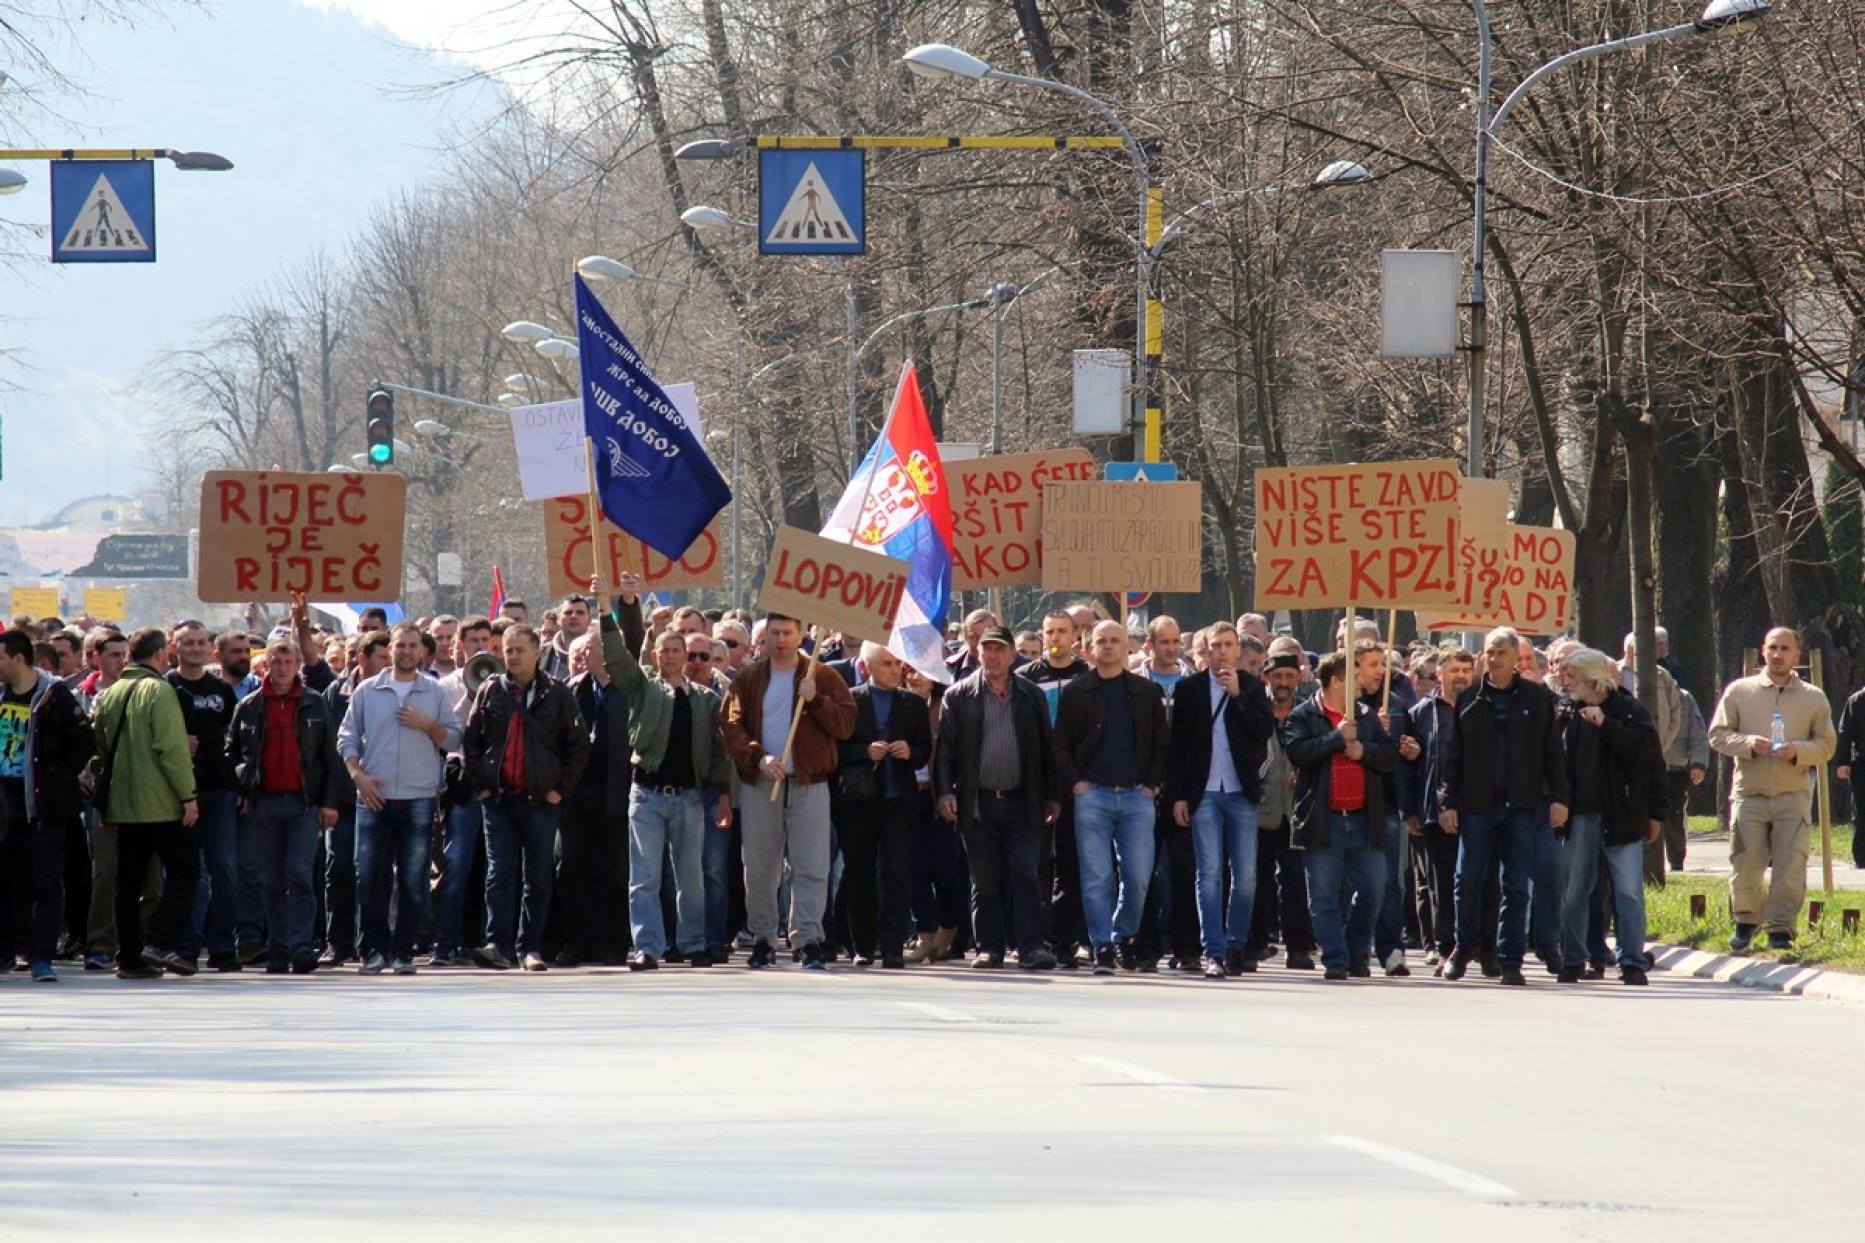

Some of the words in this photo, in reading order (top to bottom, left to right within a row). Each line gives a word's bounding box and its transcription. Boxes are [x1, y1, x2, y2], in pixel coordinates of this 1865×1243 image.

[526, 405, 581, 428] OSTAVI
[962, 471, 1022, 498] KAD
[1360, 509, 1427, 540] STE
[265, 526, 324, 554] JE
[951, 539, 1043, 580] AKO
[1265, 557, 1328, 597] ZA
[1350, 515, 1456, 600] KPZ!
[1535, 568, 1568, 592] NA
